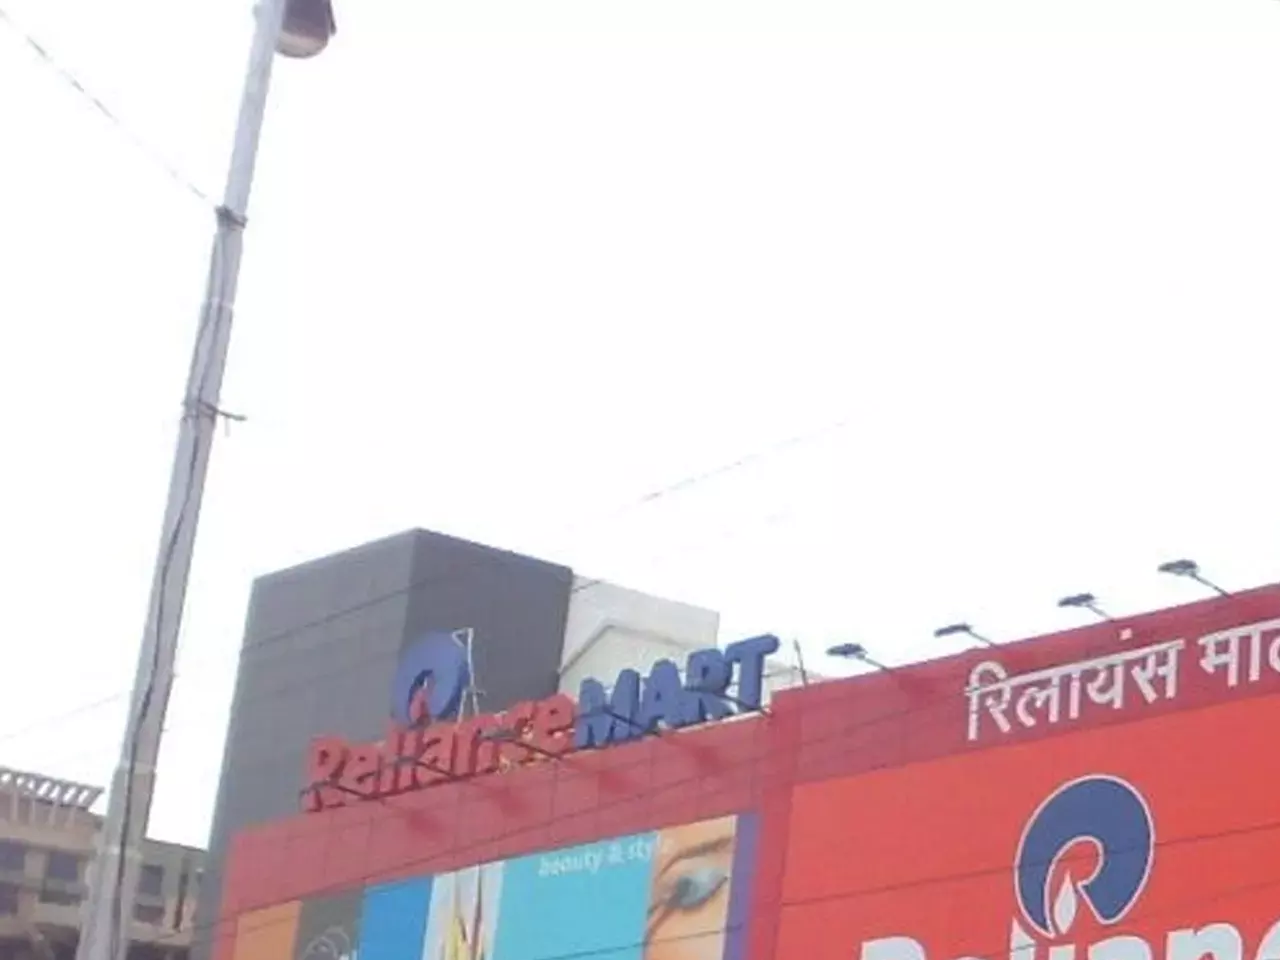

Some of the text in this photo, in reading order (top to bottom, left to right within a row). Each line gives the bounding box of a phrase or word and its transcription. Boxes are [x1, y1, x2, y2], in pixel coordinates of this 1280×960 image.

[965, 628, 1184, 741] रिलायंस
[538, 850, 601, 877] beauty
[608, 840, 624, 864] &
